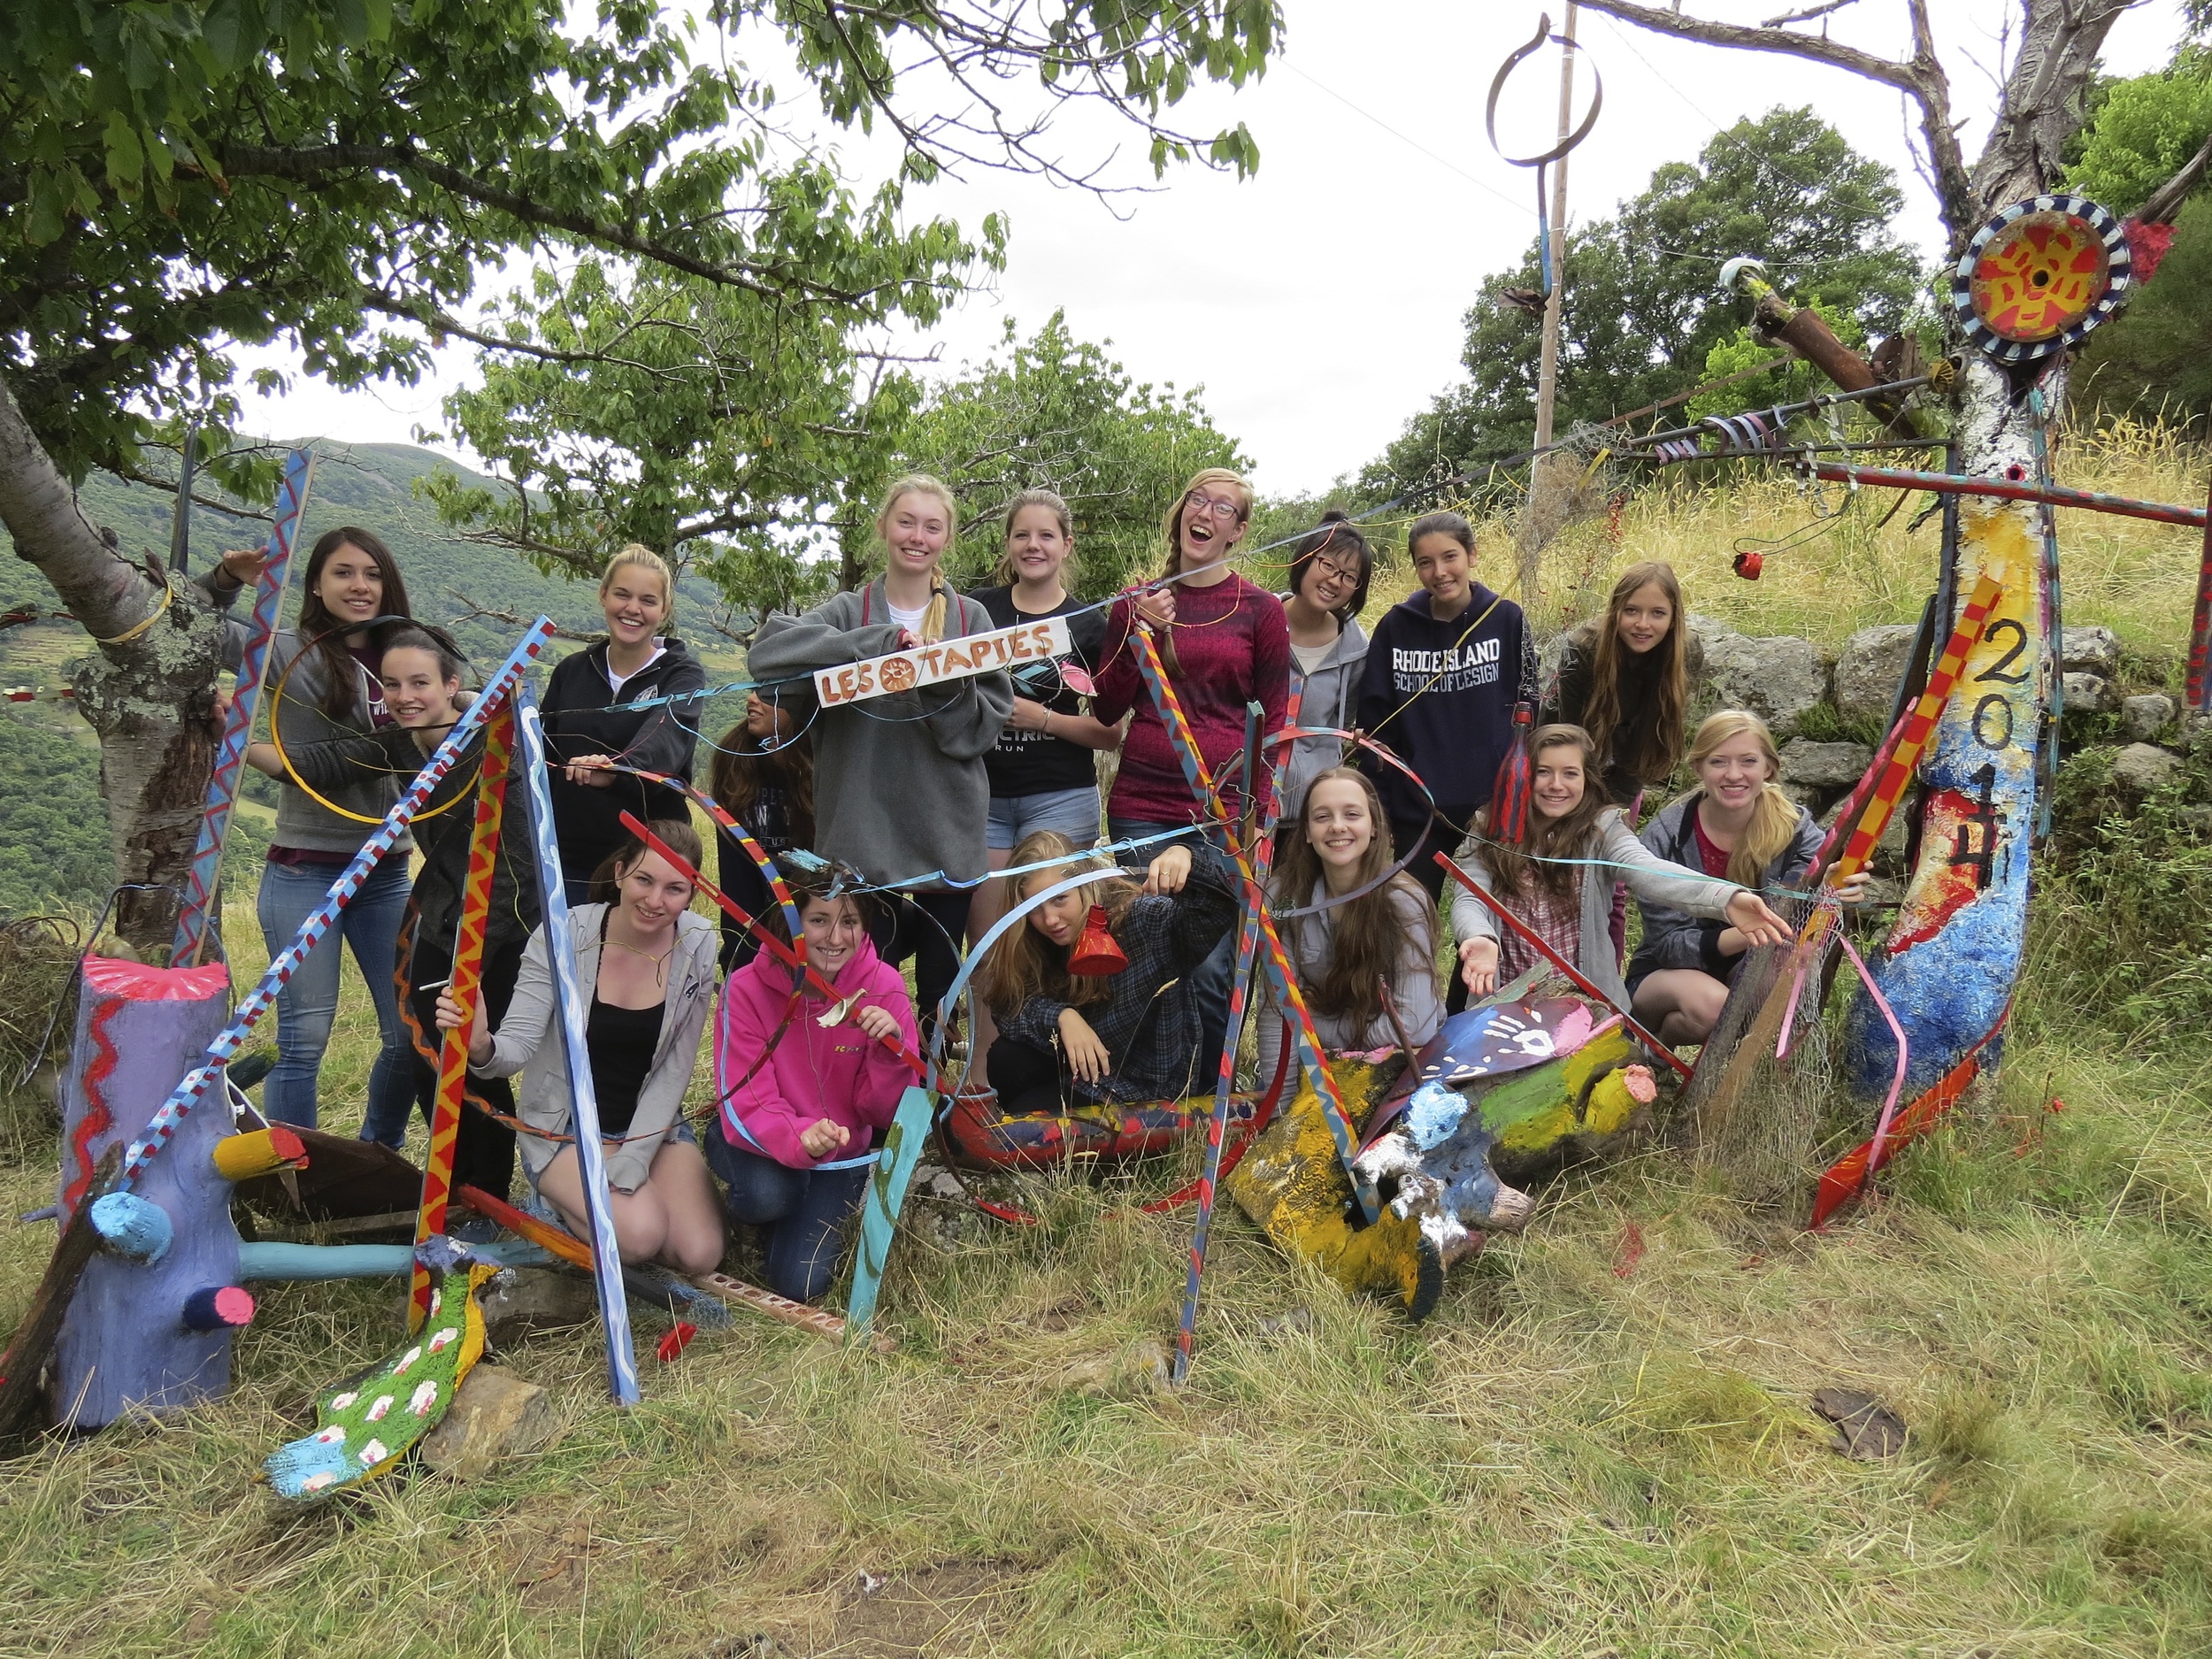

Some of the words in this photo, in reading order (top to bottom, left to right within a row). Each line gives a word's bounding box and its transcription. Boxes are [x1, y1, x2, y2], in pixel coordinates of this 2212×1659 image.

[822, 664, 875, 703] LES
[918, 625, 1054, 678] TAPIES
[1392, 648, 1442, 673] RHODE
[1442, 638, 1500, 672] ISLAND
[1393, 672, 1439, 693] SCHOOL
[1440, 675, 1455, 693] OF
[1455, 663, 1500, 690] DESIGN
[998, 728, 1056, 741] CTRIC
